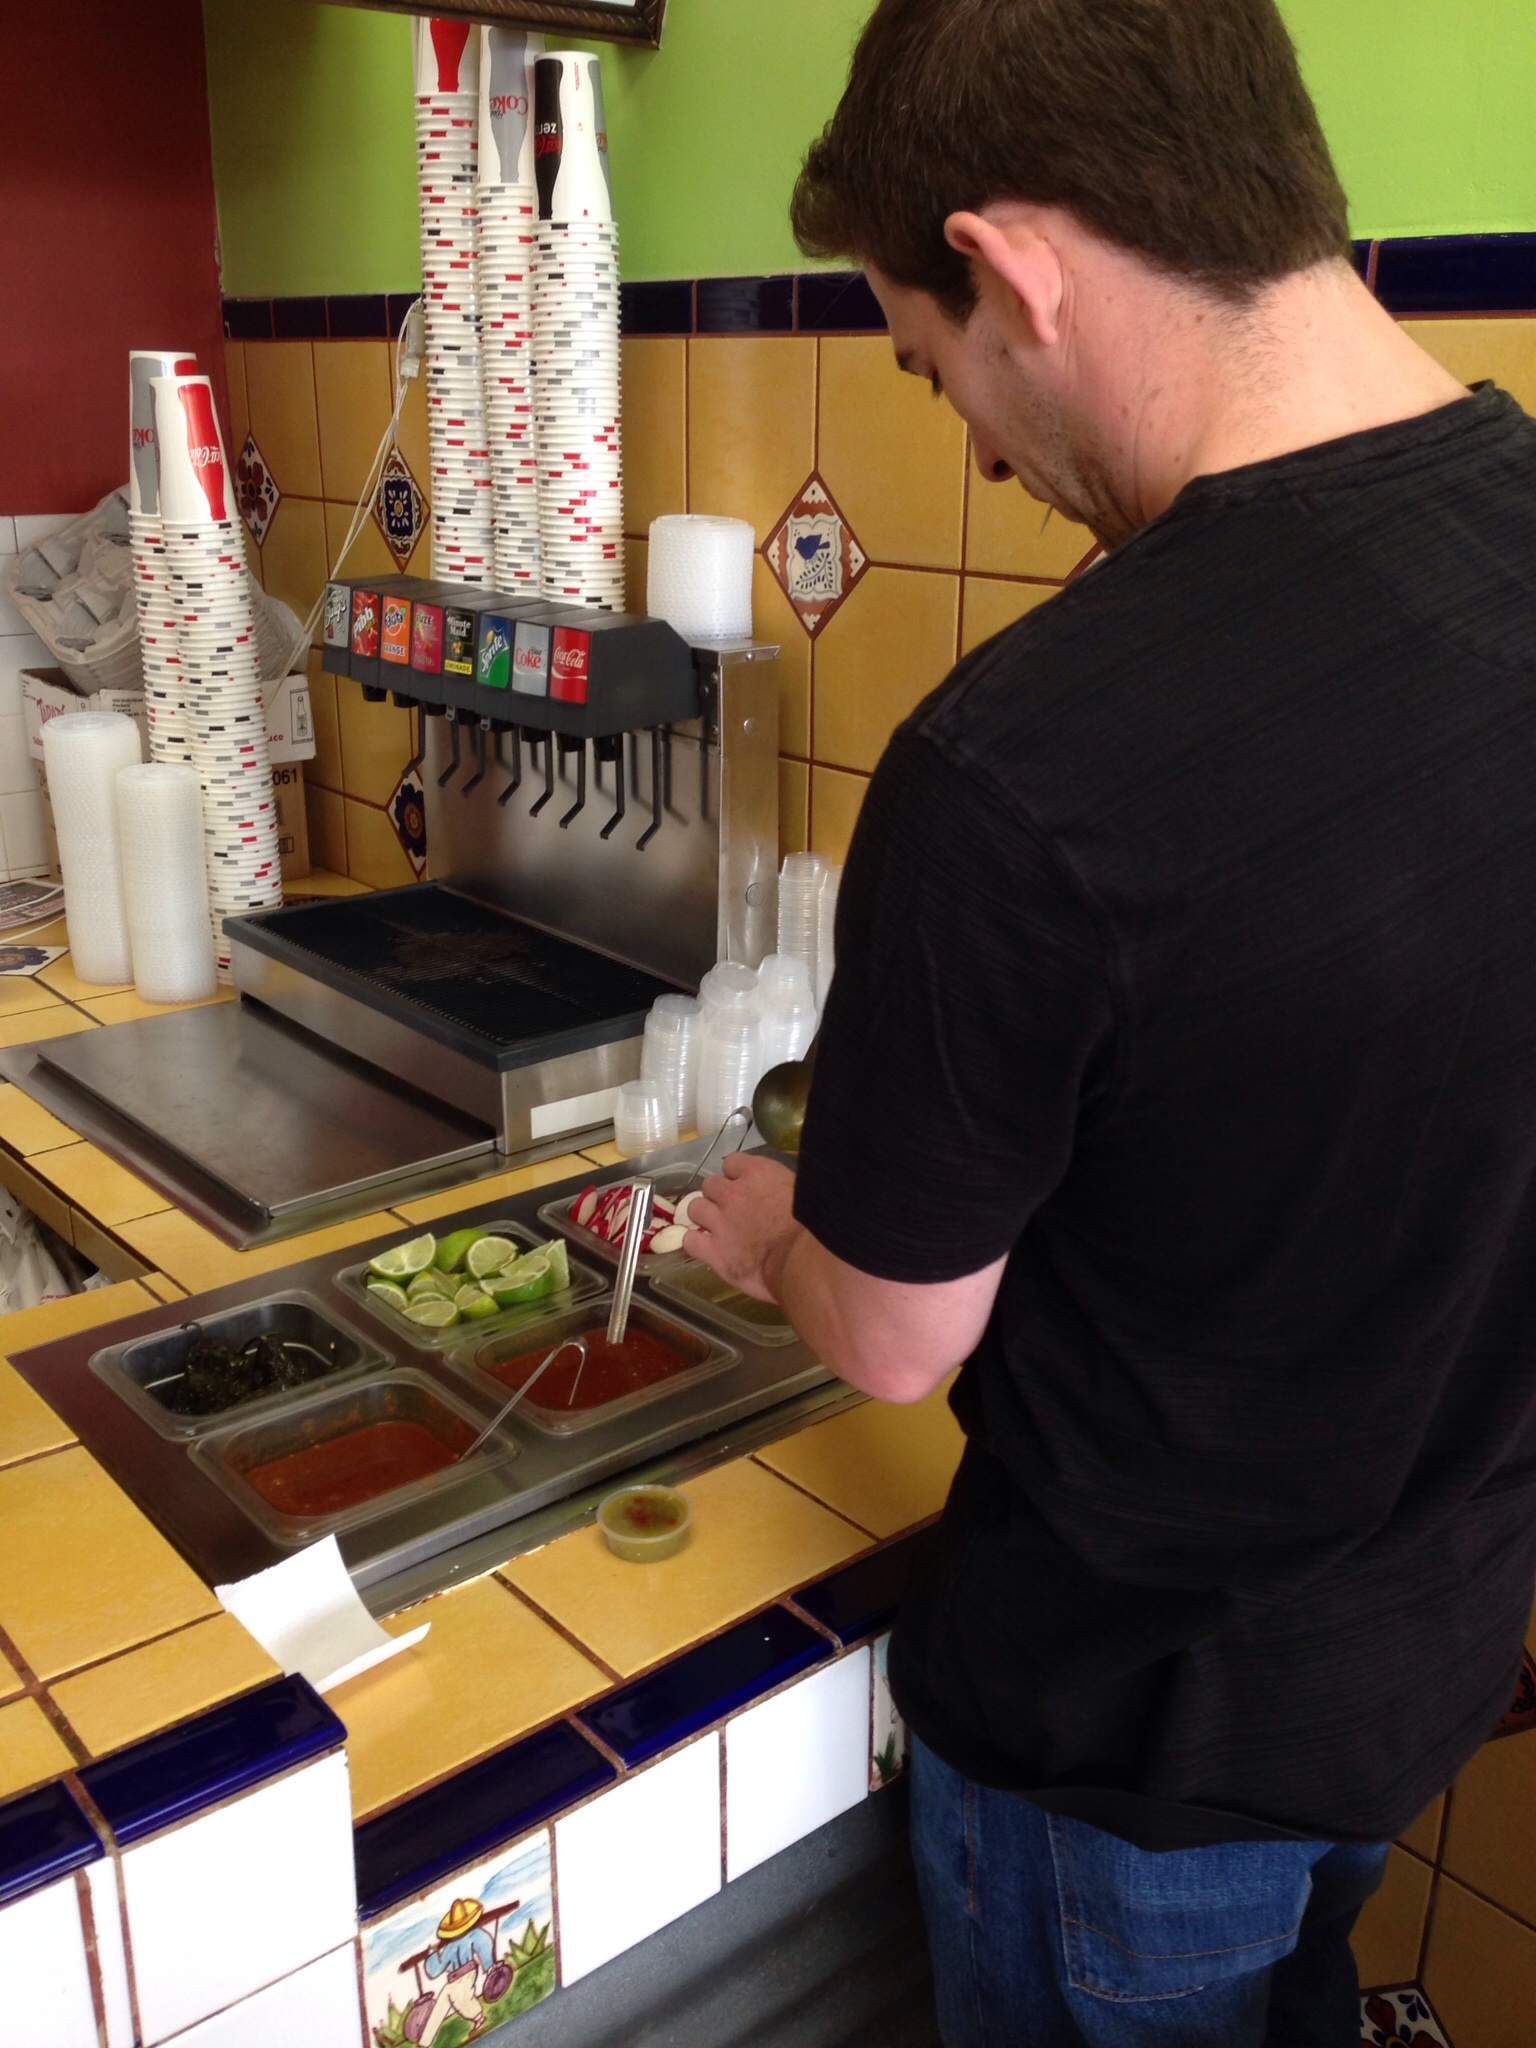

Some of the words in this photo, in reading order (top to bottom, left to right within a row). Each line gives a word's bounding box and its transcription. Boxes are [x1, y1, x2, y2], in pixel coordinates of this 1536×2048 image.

[490, 95, 528, 115] Coke
[537, 122, 557, 134] zer
[353, 605, 374, 639] Pibb
[447, 616, 471, 629] Minute
[383, 642, 406, 656] ORANGE
[481, 635, 502, 672] Sprite
[515, 648, 542, 669] Coke
